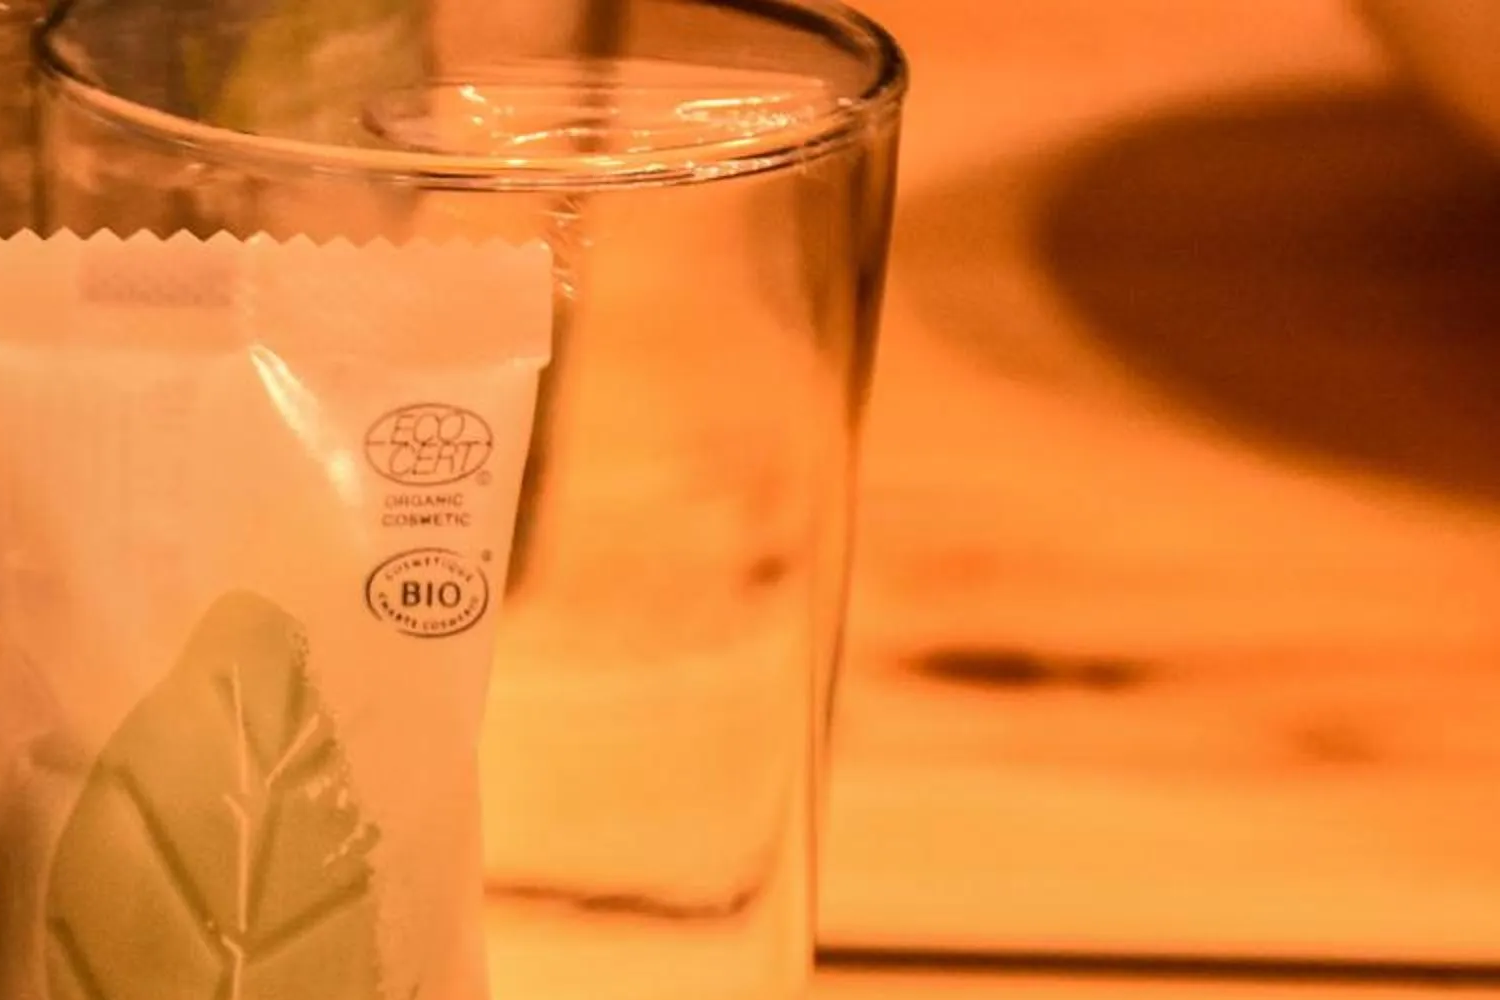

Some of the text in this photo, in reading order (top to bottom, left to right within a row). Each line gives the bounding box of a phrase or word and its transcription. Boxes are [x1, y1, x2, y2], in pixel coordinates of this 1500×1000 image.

[384, 493, 465, 510] ORGANIC
[381, 513, 472, 529] COSMETIC
[401, 580, 463, 609] BIO
